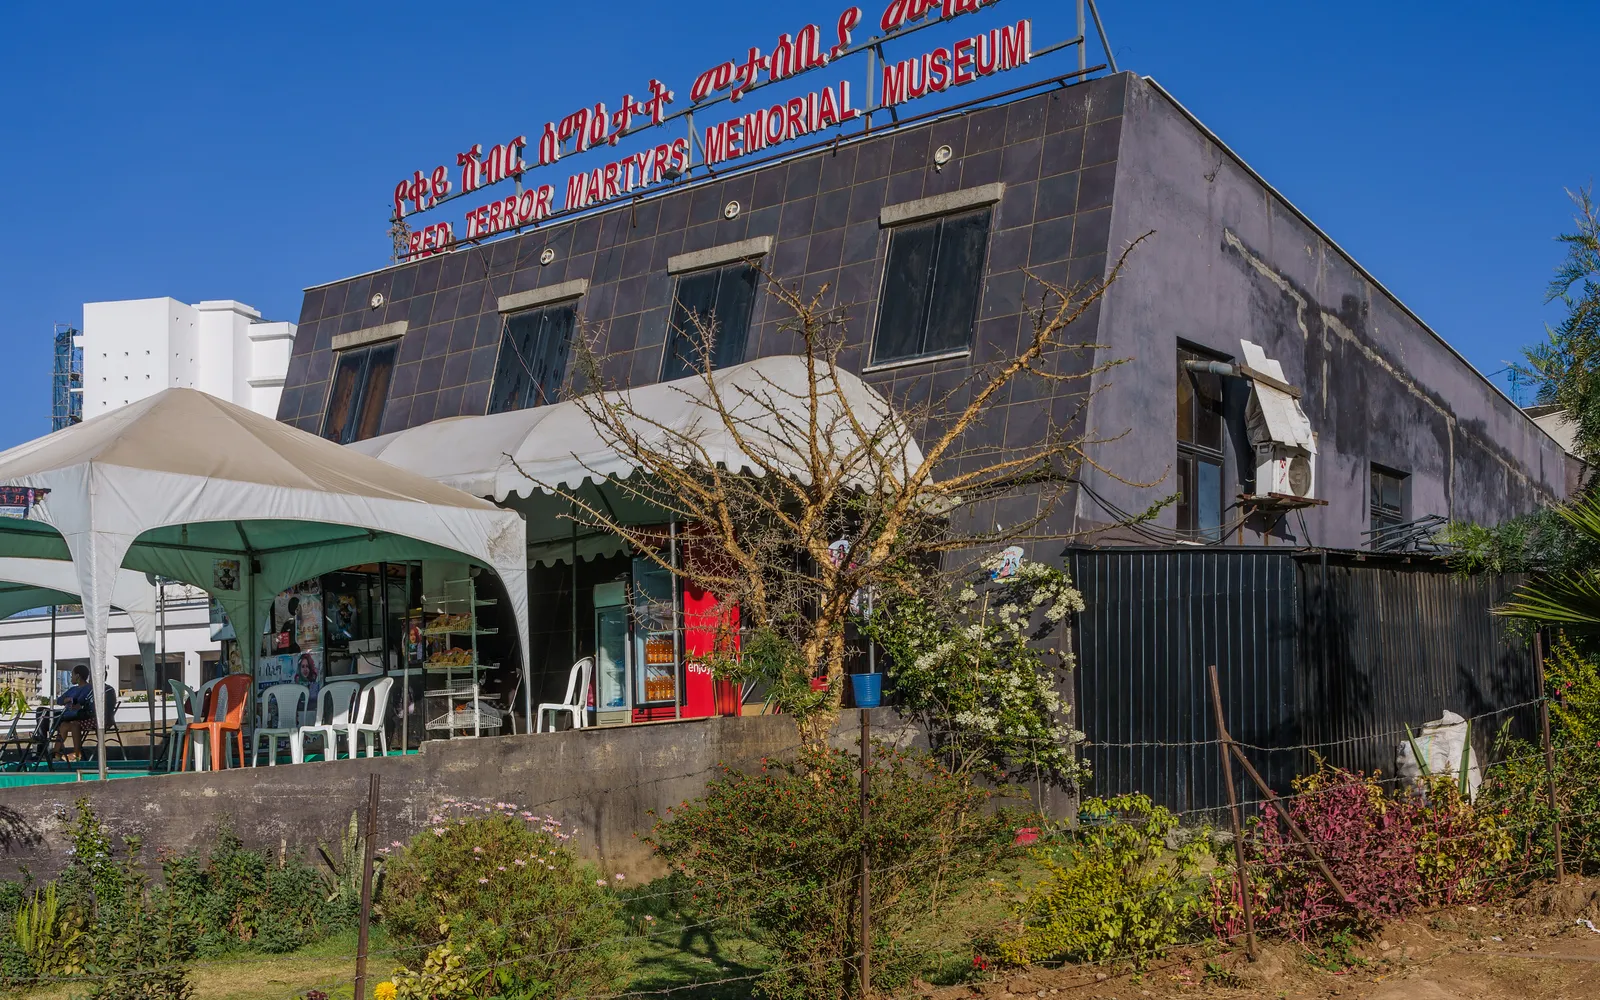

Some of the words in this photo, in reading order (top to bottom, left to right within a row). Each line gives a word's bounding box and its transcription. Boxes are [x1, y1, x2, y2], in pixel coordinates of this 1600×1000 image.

[394, 166, 453, 219] የቀይ
[457, 135, 526, 193] ሽብር
[539, 79, 674, 165] ሰማዕታት
[690, 6, 863, 102] መታሰቢያ
[407, 222, 452, 261] RED
[465, 185, 555, 239] TERROR
[564, 138, 690, 210] MARTYRS
[704, 80, 861, 164] MEMORIAL
[882, 19, 1032, 107] MUSEUM
